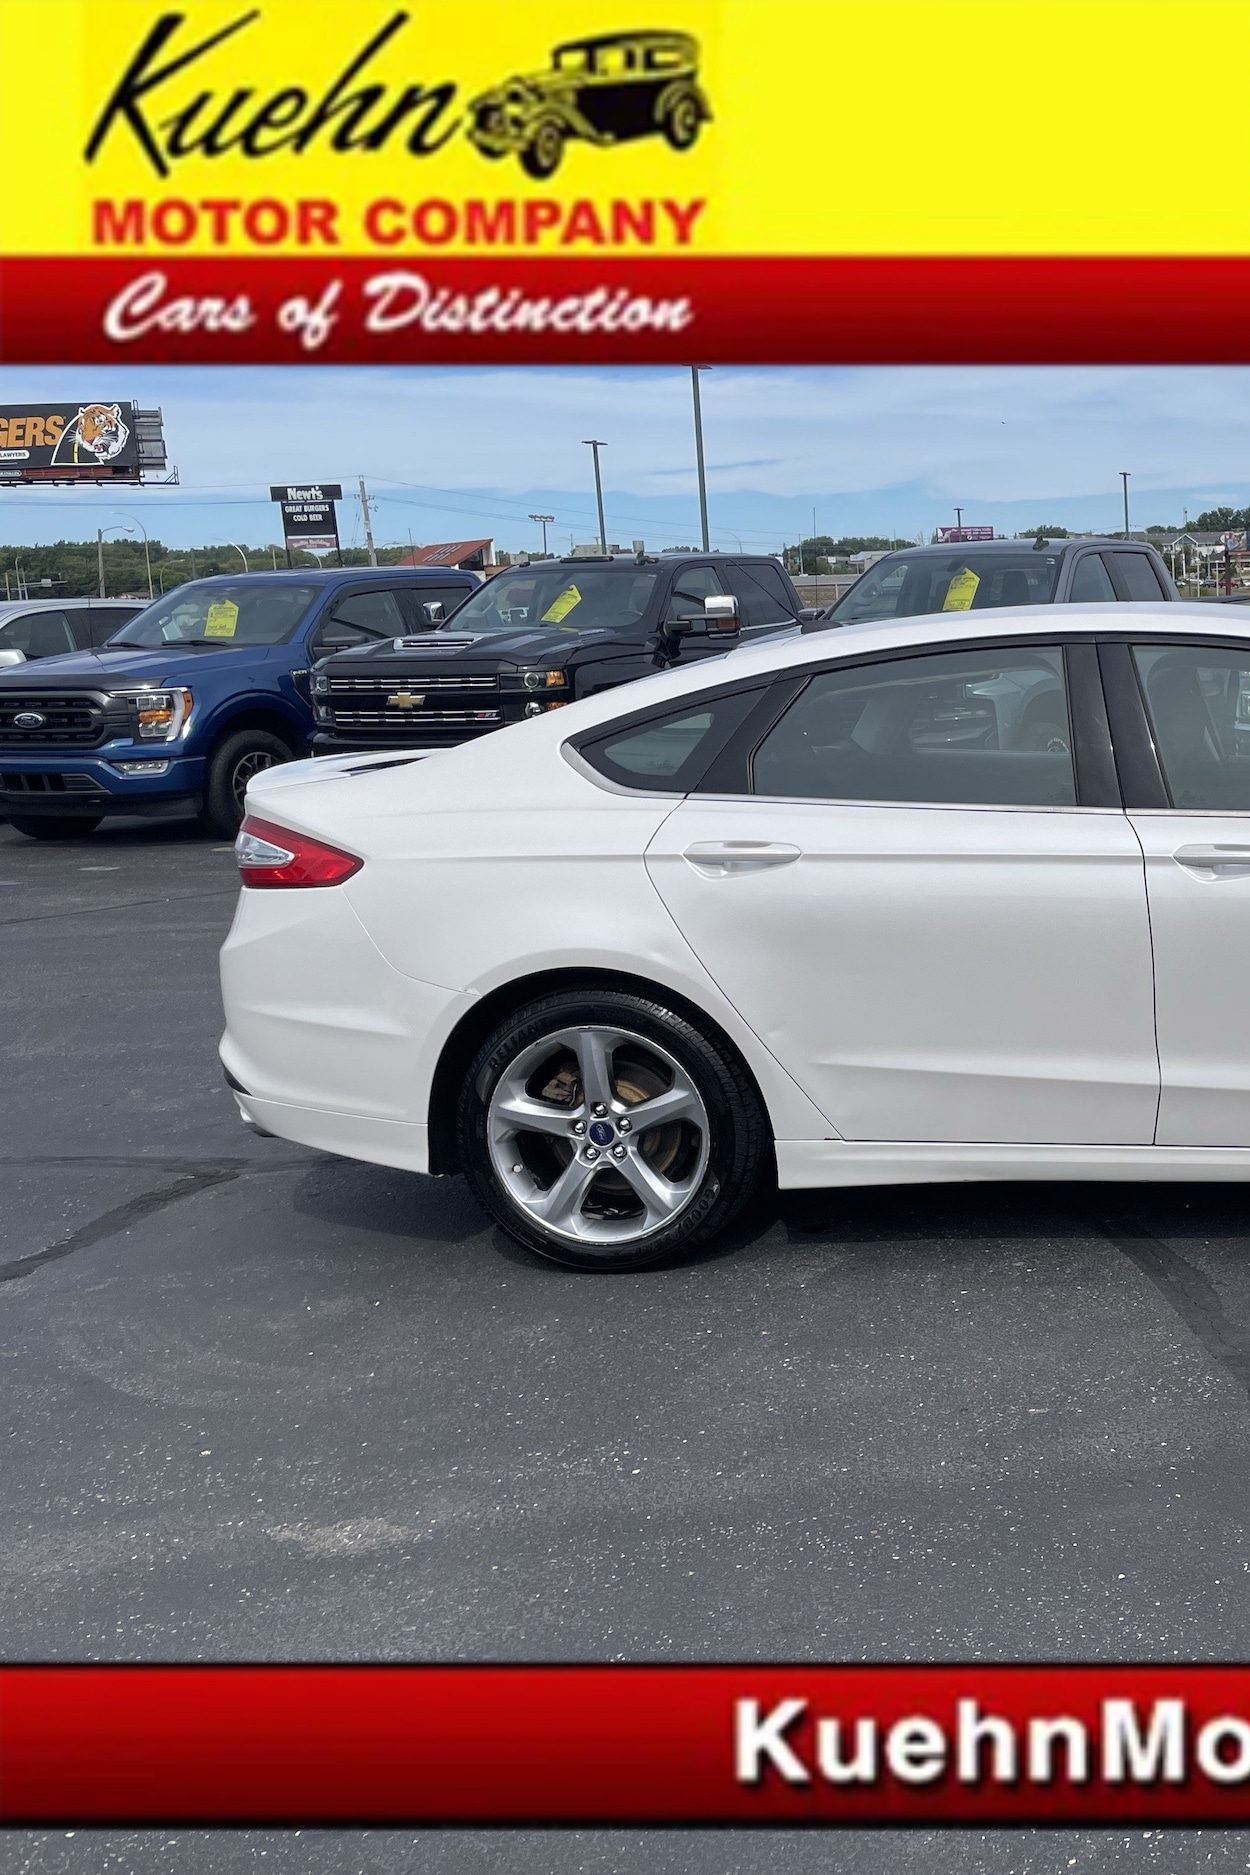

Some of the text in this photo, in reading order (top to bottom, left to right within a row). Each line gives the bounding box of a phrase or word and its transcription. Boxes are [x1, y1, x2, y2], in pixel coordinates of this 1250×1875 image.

[287, 486, 323, 500] Newt's
[285, 504, 329, 513] GREAT BURGERS
